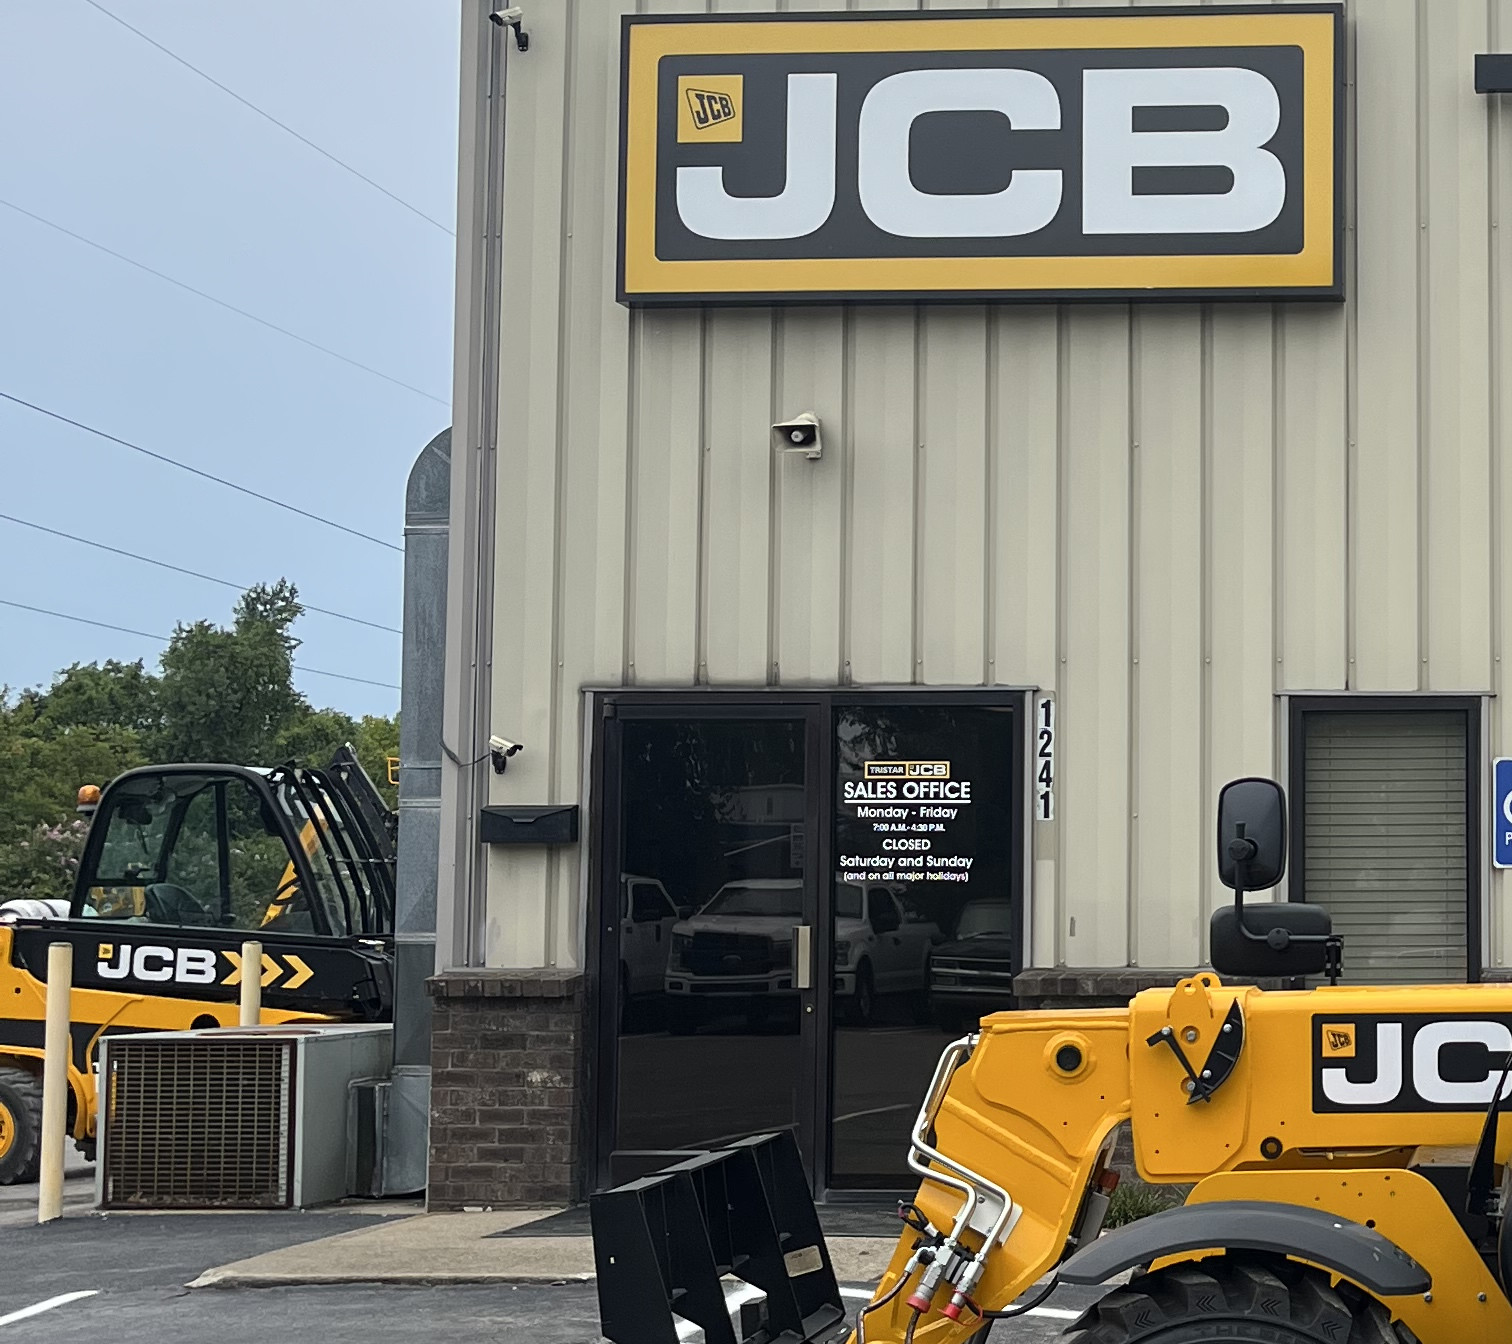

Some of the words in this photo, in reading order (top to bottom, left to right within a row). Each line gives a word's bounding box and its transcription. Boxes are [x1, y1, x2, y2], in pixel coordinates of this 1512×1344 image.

[695, 92, 732, 125] JCB
[676, 67, 1286, 240] JCB
[1038, 699, 1053, 819] 1241
[869, 766, 904, 774] TRISTAR
[909, 764, 946, 776] JCB
[843, 781, 897, 799] SALES
[902, 781, 971, 799] OFFICE
[857, 806, 909, 819] Monday
[919, 806, 958, 819] Friday
[882, 838, 931, 850] CLOSED
[840, 855, 895, 868] Saturday
[897, 855, 924, 866] and
[926, 855, 973, 869] Sunday
[882, 871, 895, 880] all
[896, 871, 924, 882] major
[97, 944, 217, 984] JCB
